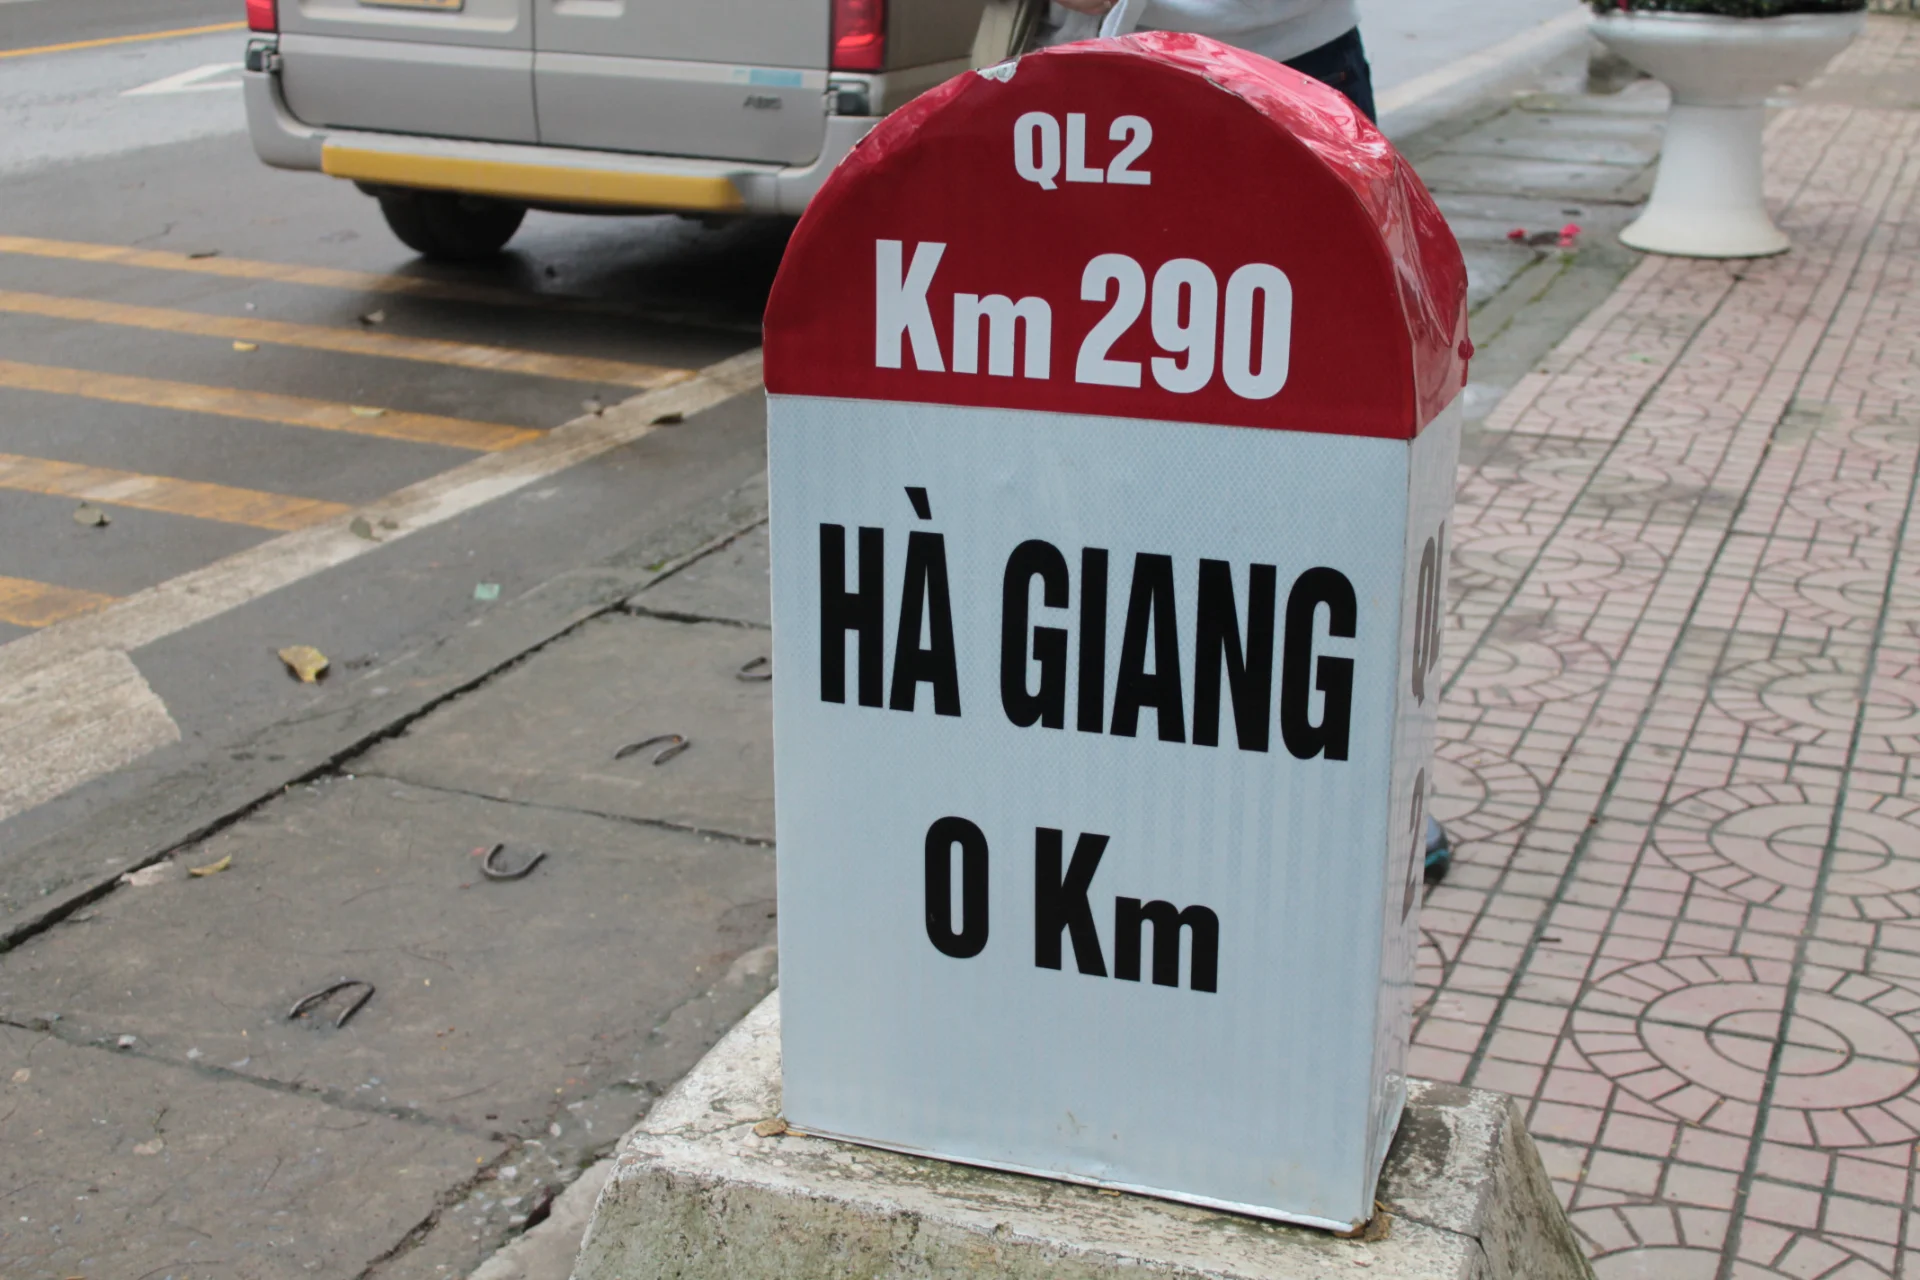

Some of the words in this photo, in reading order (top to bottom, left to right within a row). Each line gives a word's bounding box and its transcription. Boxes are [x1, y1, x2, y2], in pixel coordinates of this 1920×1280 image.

[1013, 111, 1153, 190] QL2
[875, 239, 1052, 380] Km
[1075, 253, 1293, 400] 290
[820, 486, 962, 718] HÀ
[1000, 538, 1358, 762] GIANG
[1410, 519, 1446, 709] QL
[924, 815, 990, 959] 0
[1035, 826, 1220, 994] Km
